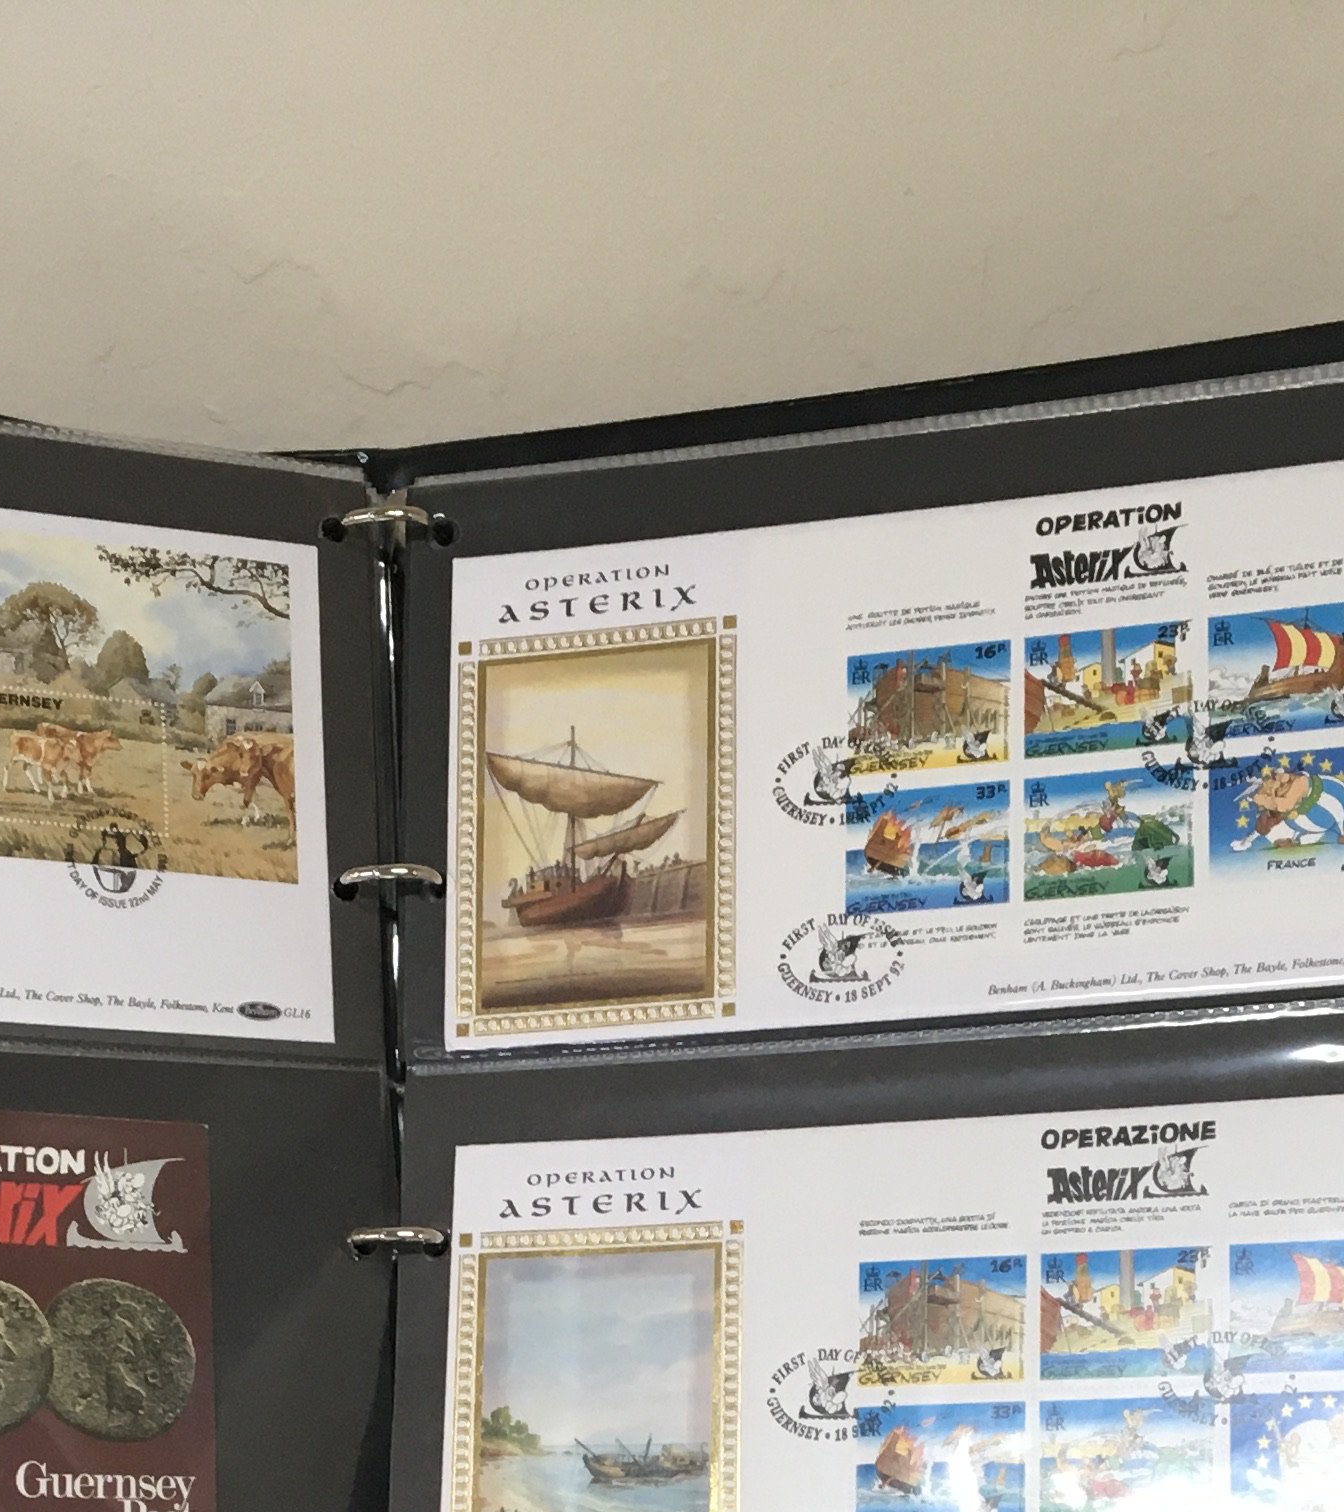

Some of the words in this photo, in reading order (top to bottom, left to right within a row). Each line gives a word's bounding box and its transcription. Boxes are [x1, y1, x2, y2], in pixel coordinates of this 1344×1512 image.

[1036, 501, 1183, 537] OPERATION
[525, 564, 670, 591] OPERATION
[499, 584, 698, 624] ASTERIX
[777, 742, 811, 775] FIRST
[772, 786, 828, 826] GUERNSEY
[1267, 858, 1316, 870] FRANCE
[70, 871, 88, 889] DAY
[85, 888, 98, 899] OF
[98, 896, 127, 908] ISSUE
[147, 876, 163, 896] MAY
[781, 918, 816, 951] FIRST
[777, 962, 833, 1003] GUERNSEY
[861, 975, 900, 1000] SEPT
[988, 984, 1027, 995] Benham
[1051, 977, 1116, 990] Buckingham)
[1147, 972, 1165, 982] The
[1169, 970, 1198, 980] Cover
[1234, 964, 1252, 975] The
[25, 989, 42, 1001] The
[107, 995, 124, 1005] The
[1040, 1120, 1216, 1150] OPERAZIONE
[527, 1166, 676, 1188] OPERATION
[498, 1188, 703, 1219] ASTERIX
[772, 1352, 807, 1386] FIRST
[818, 1348, 841, 1361] DAY
[767, 1397, 823, 1441] GUERNSEY
[16, 1461, 196, 1512] Guernsey
